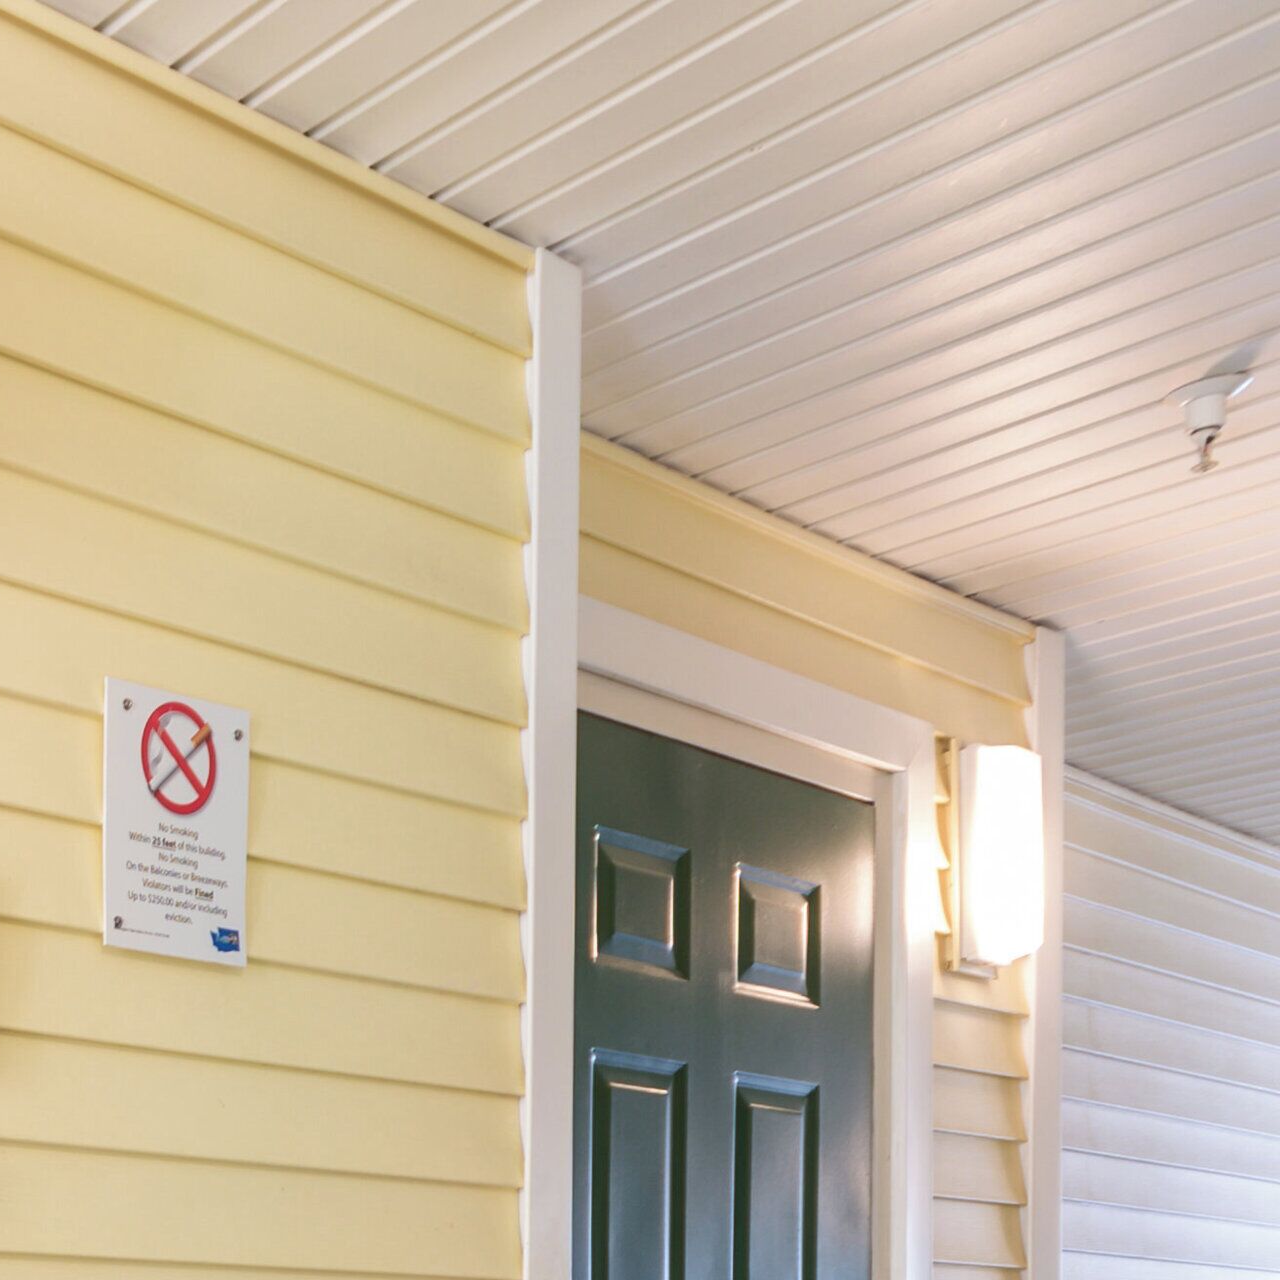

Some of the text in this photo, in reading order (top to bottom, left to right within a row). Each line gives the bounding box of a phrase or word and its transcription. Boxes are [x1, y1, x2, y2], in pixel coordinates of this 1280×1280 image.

[159, 822, 198, 841] No Smoking
[129, 831, 151, 843] Within
[152, 836, 161, 848] 25
[162, 838, 177, 850] feet
[186, 843, 198, 853] this
[126, 860, 137, 870] On
[138, 862, 149, 872] the
[150, 864, 181, 879] Balconies
[159, 852, 198, 871] No Smoking
[142, 878, 171, 893] Violators
[172, 884, 183, 894] will
[184, 886, 193, 895] be
[128, 890, 138, 902] Up
[198, 904, 228, 919] including
